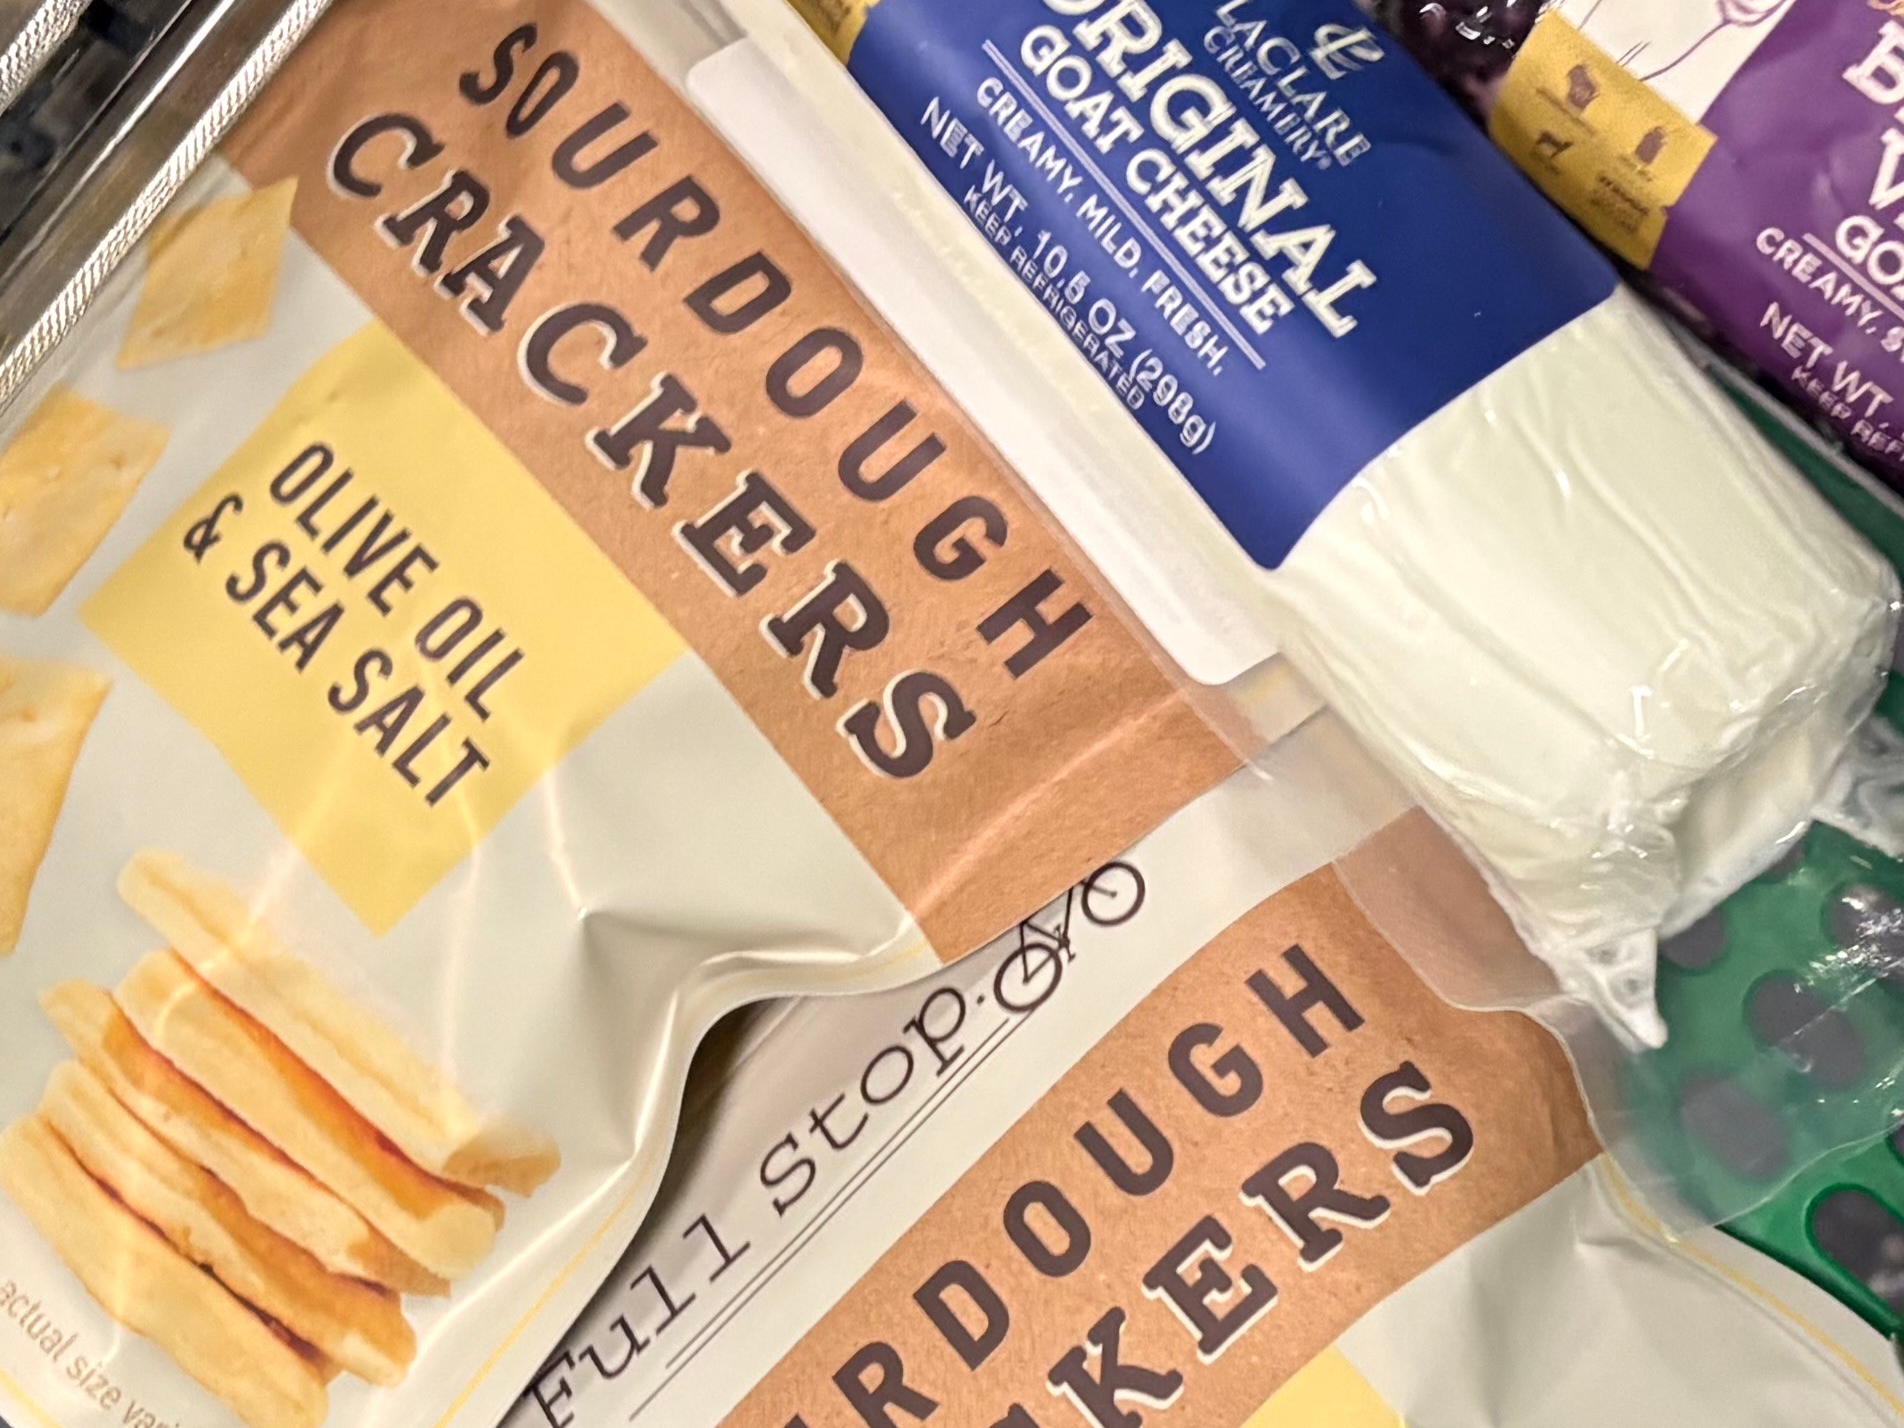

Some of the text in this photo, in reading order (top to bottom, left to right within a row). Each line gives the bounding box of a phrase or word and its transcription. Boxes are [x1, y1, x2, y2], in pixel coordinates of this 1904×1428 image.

[921, 97, 984, 168] NET
[972, 160, 1028, 236] WT.
[1033, 231, 1090, 304] 10.5
[1089, 298, 1136, 358] OZ
[1122, 349, 1215, 453] (298g)
[964, 185, 1144, 409] KEEP REFRIGERATED
[977, 78, 1228, 375] CREAMY. MILD. FRESH.
[1021, 26, 1293, 334] GOAT CHEESE
[333, 113, 976, 778] CRACKERS
[458, 7, 1093, 679] SOURDOUGH
[1760, 302, 1834, 368] NET
[1833, 360, 1893, 428] WT.
[183, 494, 489, 806] & SEA SALT
[270, 444, 523, 722] OLIVE OIL
[67, 1358, 122, 1410] size
